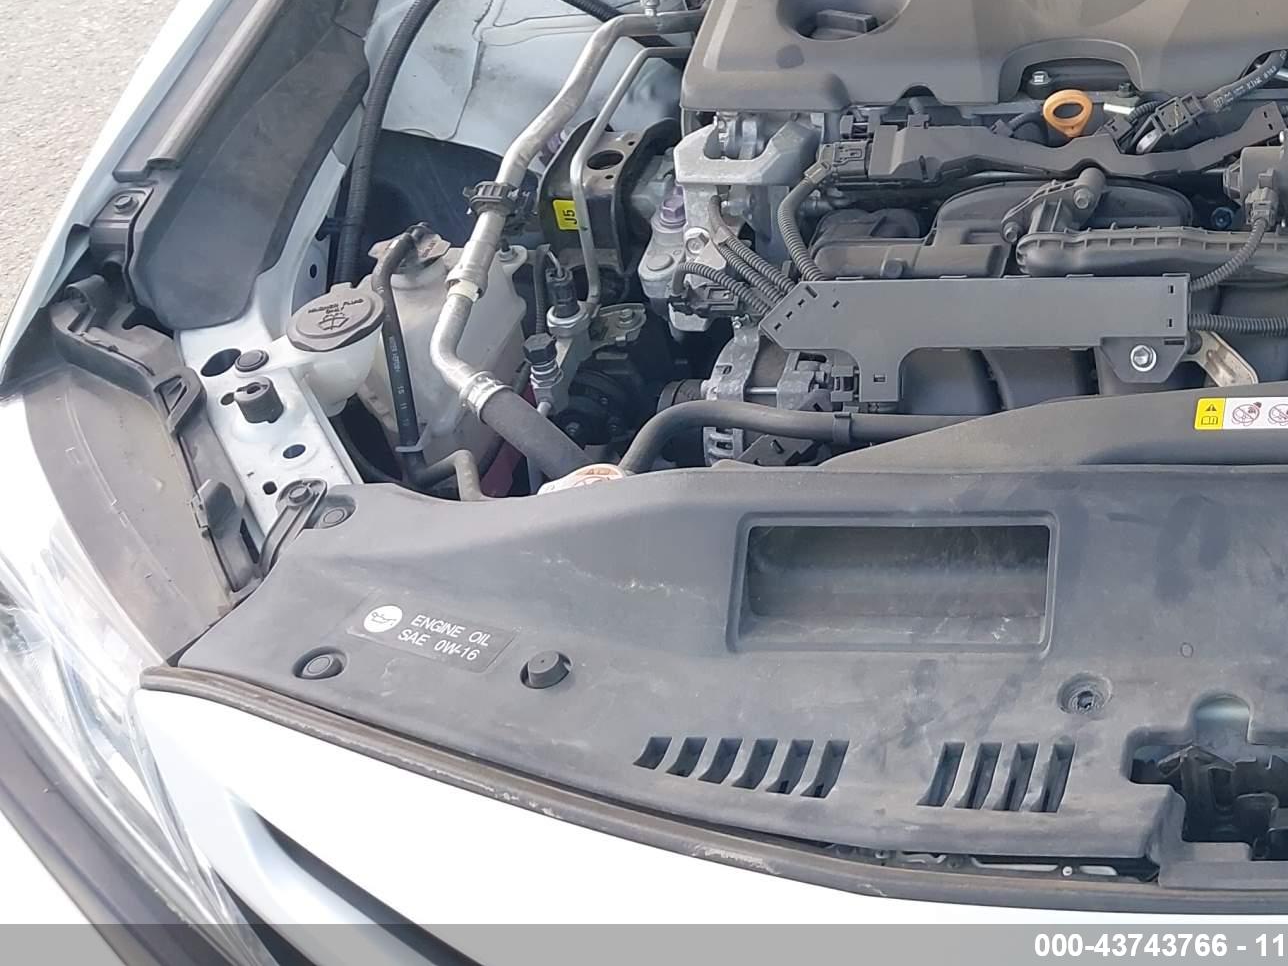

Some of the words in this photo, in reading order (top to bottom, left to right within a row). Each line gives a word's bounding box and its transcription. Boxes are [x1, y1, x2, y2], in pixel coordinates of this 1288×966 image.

[562, 209, 578, 225] J5
[398, 629, 431, 646] SAE
[434, 639, 481, 661] 0W-16
[411, 614, 465, 638] ENGINE
[468, 631, 491, 647] OIL
